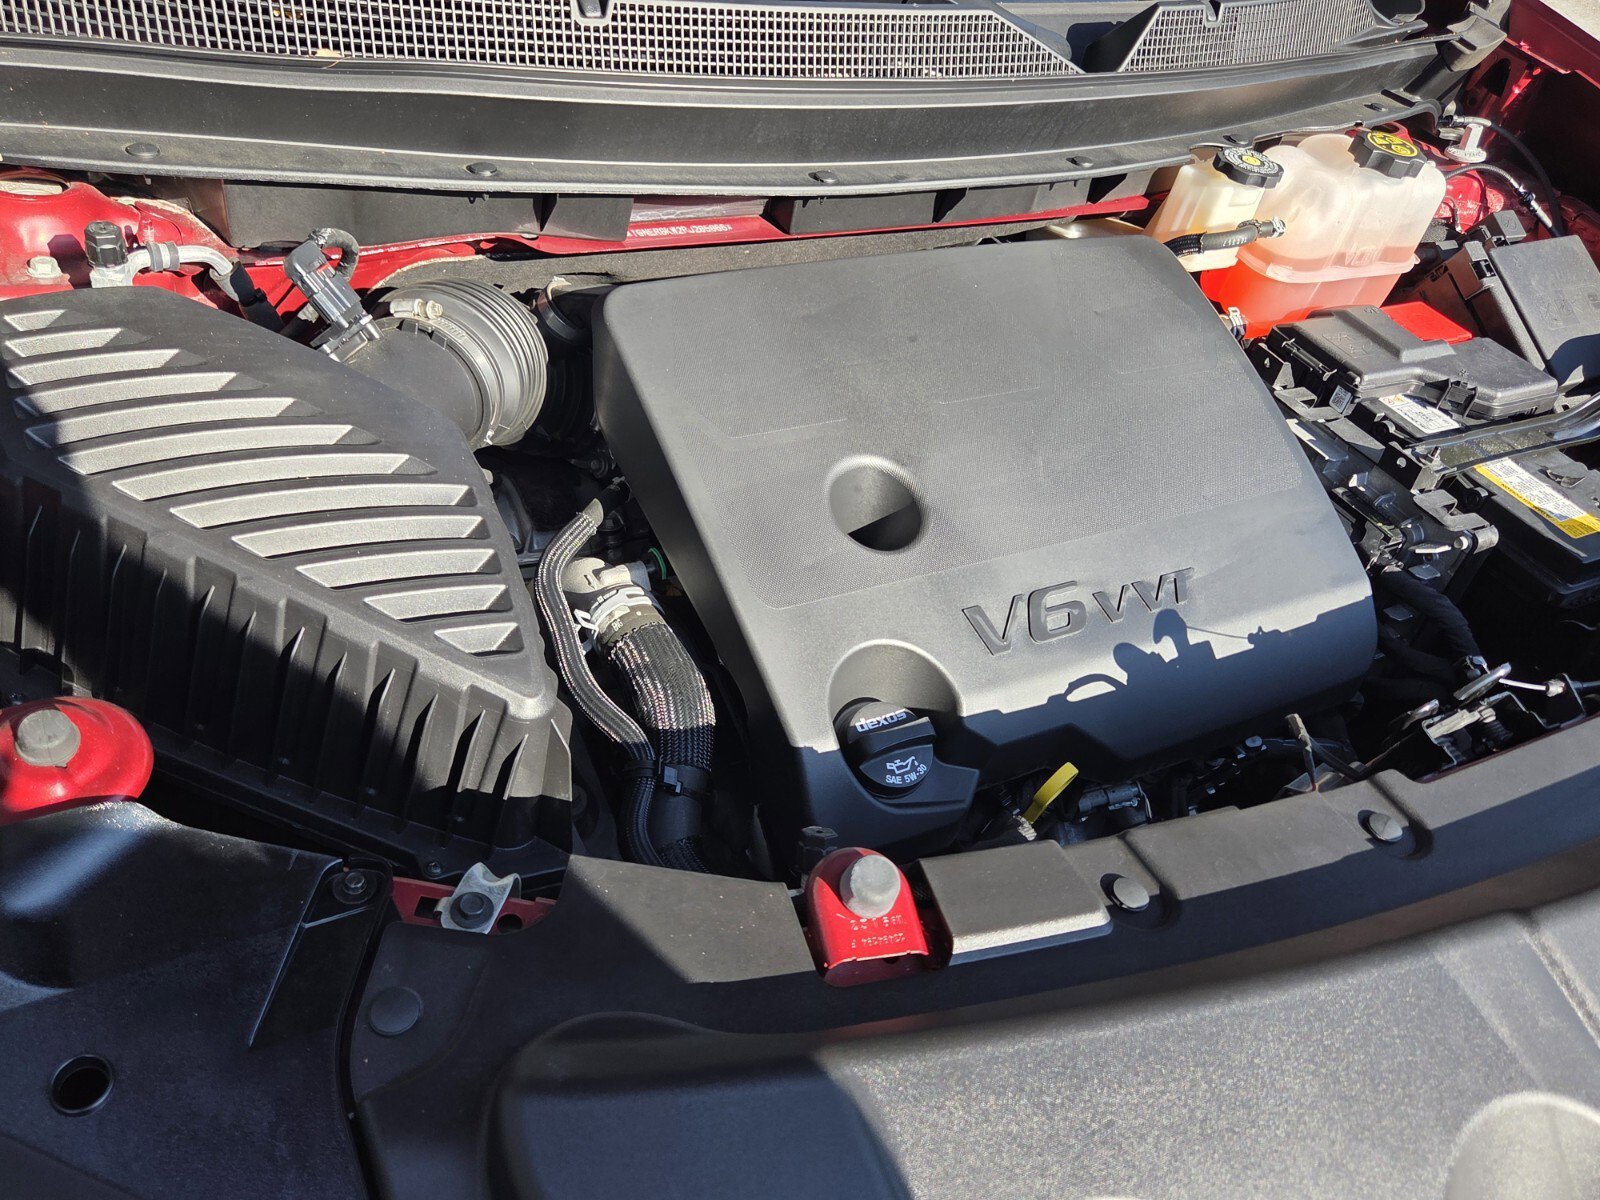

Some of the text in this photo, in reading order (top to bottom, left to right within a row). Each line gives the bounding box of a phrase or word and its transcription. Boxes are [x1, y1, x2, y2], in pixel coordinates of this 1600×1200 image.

[961, 567, 1195, 656] V6 VVT
[855, 708, 907, 733] dexos
[885, 763, 927, 784] SAE 5W-30
